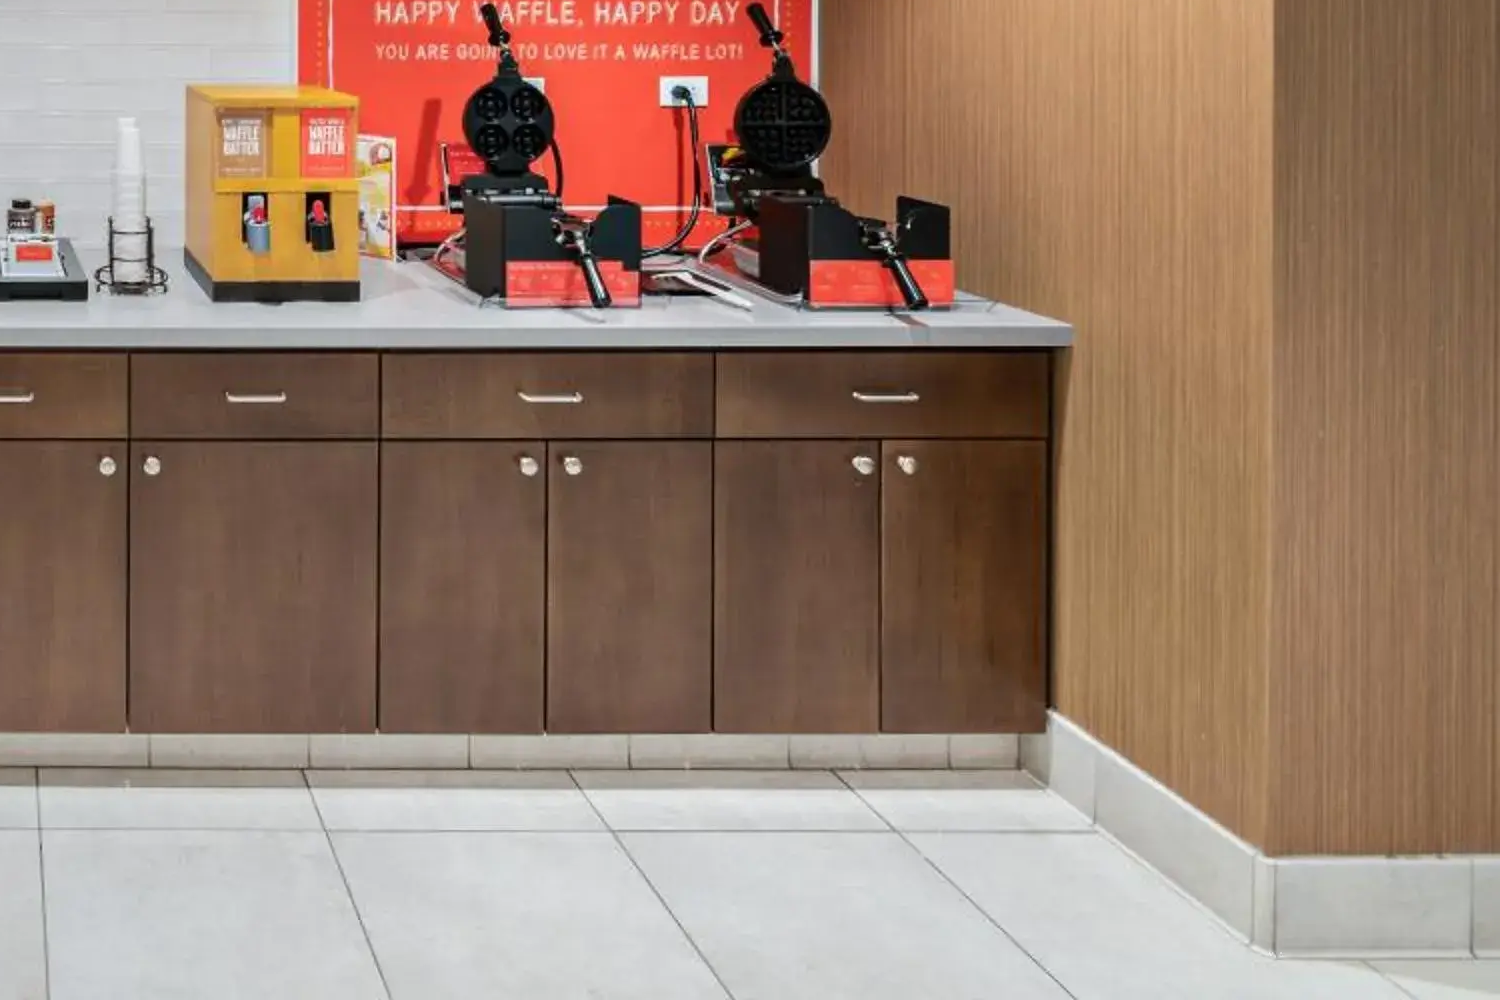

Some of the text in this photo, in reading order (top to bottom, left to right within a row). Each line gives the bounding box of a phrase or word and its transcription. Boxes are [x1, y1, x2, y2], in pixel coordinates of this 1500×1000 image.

[375, 0, 460, 25] HAPPY
[594, 0, 679, 25] HAPPY
[689, 0, 740, 25] DAY
[375, 43, 744, 61] YOU ARE GOIN TO LOVE IT A WAFFLE LOT!
[308, 126, 344, 140] WAFFLE
